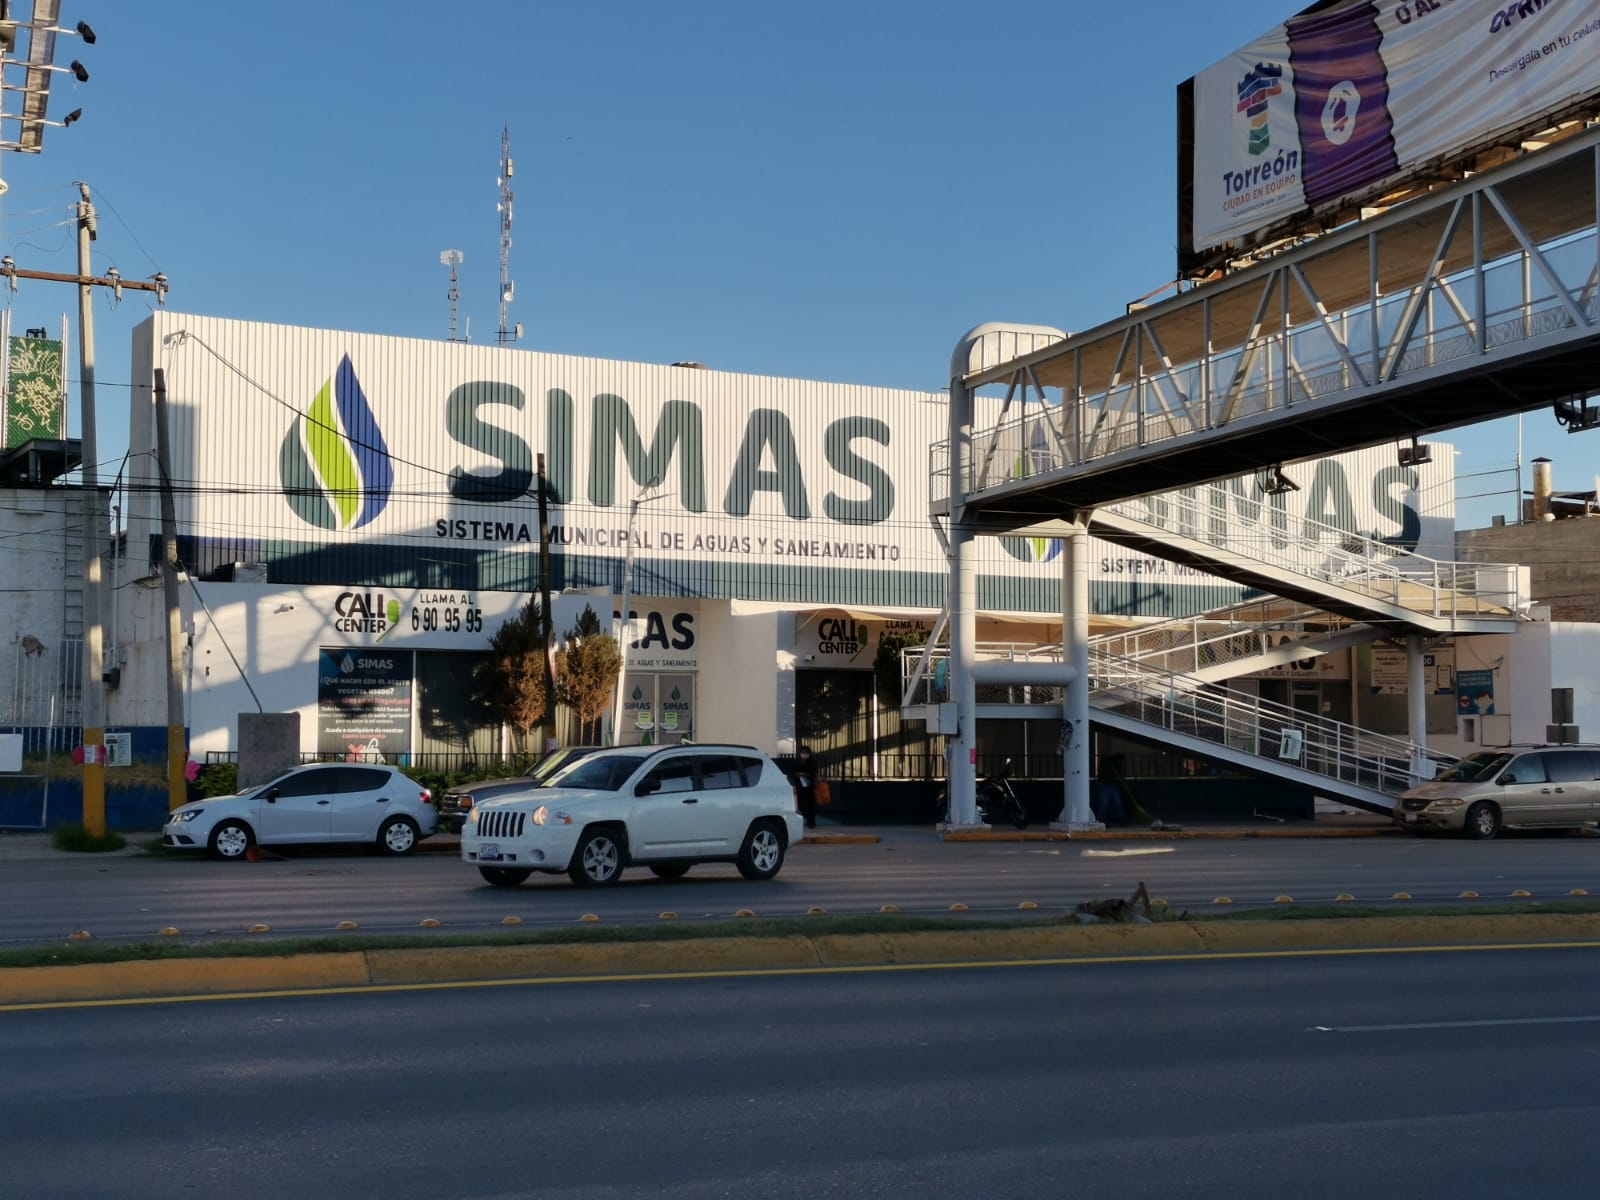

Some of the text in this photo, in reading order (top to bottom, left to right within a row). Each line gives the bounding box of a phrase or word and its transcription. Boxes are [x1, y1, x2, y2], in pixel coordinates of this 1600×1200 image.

[1542, 41, 1557, 56] en
[1223, 149, 1298, 196] Torreón
[1223, 192, 1251, 212] CIUDAD
[1253, 187, 1263, 200] EN
[1266, 174, 1296, 194] EQUIPO
[445, 380, 896, 525] SIMAS
[436, 518, 901, 561] SISTEMA MUNICIPAL DE AGUAS Y SANEAMIENTO
[1101, 557, 1168, 576] SISTEMA
[335, 591, 386, 618] CALL
[420, 593, 474, 604] LLAMA AL
[335, 618, 386, 633] CENTER
[411, 606, 482, 633] 6 90 95 95
[885, 620, 925, 630] LLAMA AL
[818, 618, 858, 642] CALL
[818, 641, 858, 655] CENTER
[357, 659, 394, 670] SIMAS
[624, 702, 650, 711] SIMAS
[663, 702, 689, 711] SIMAS
